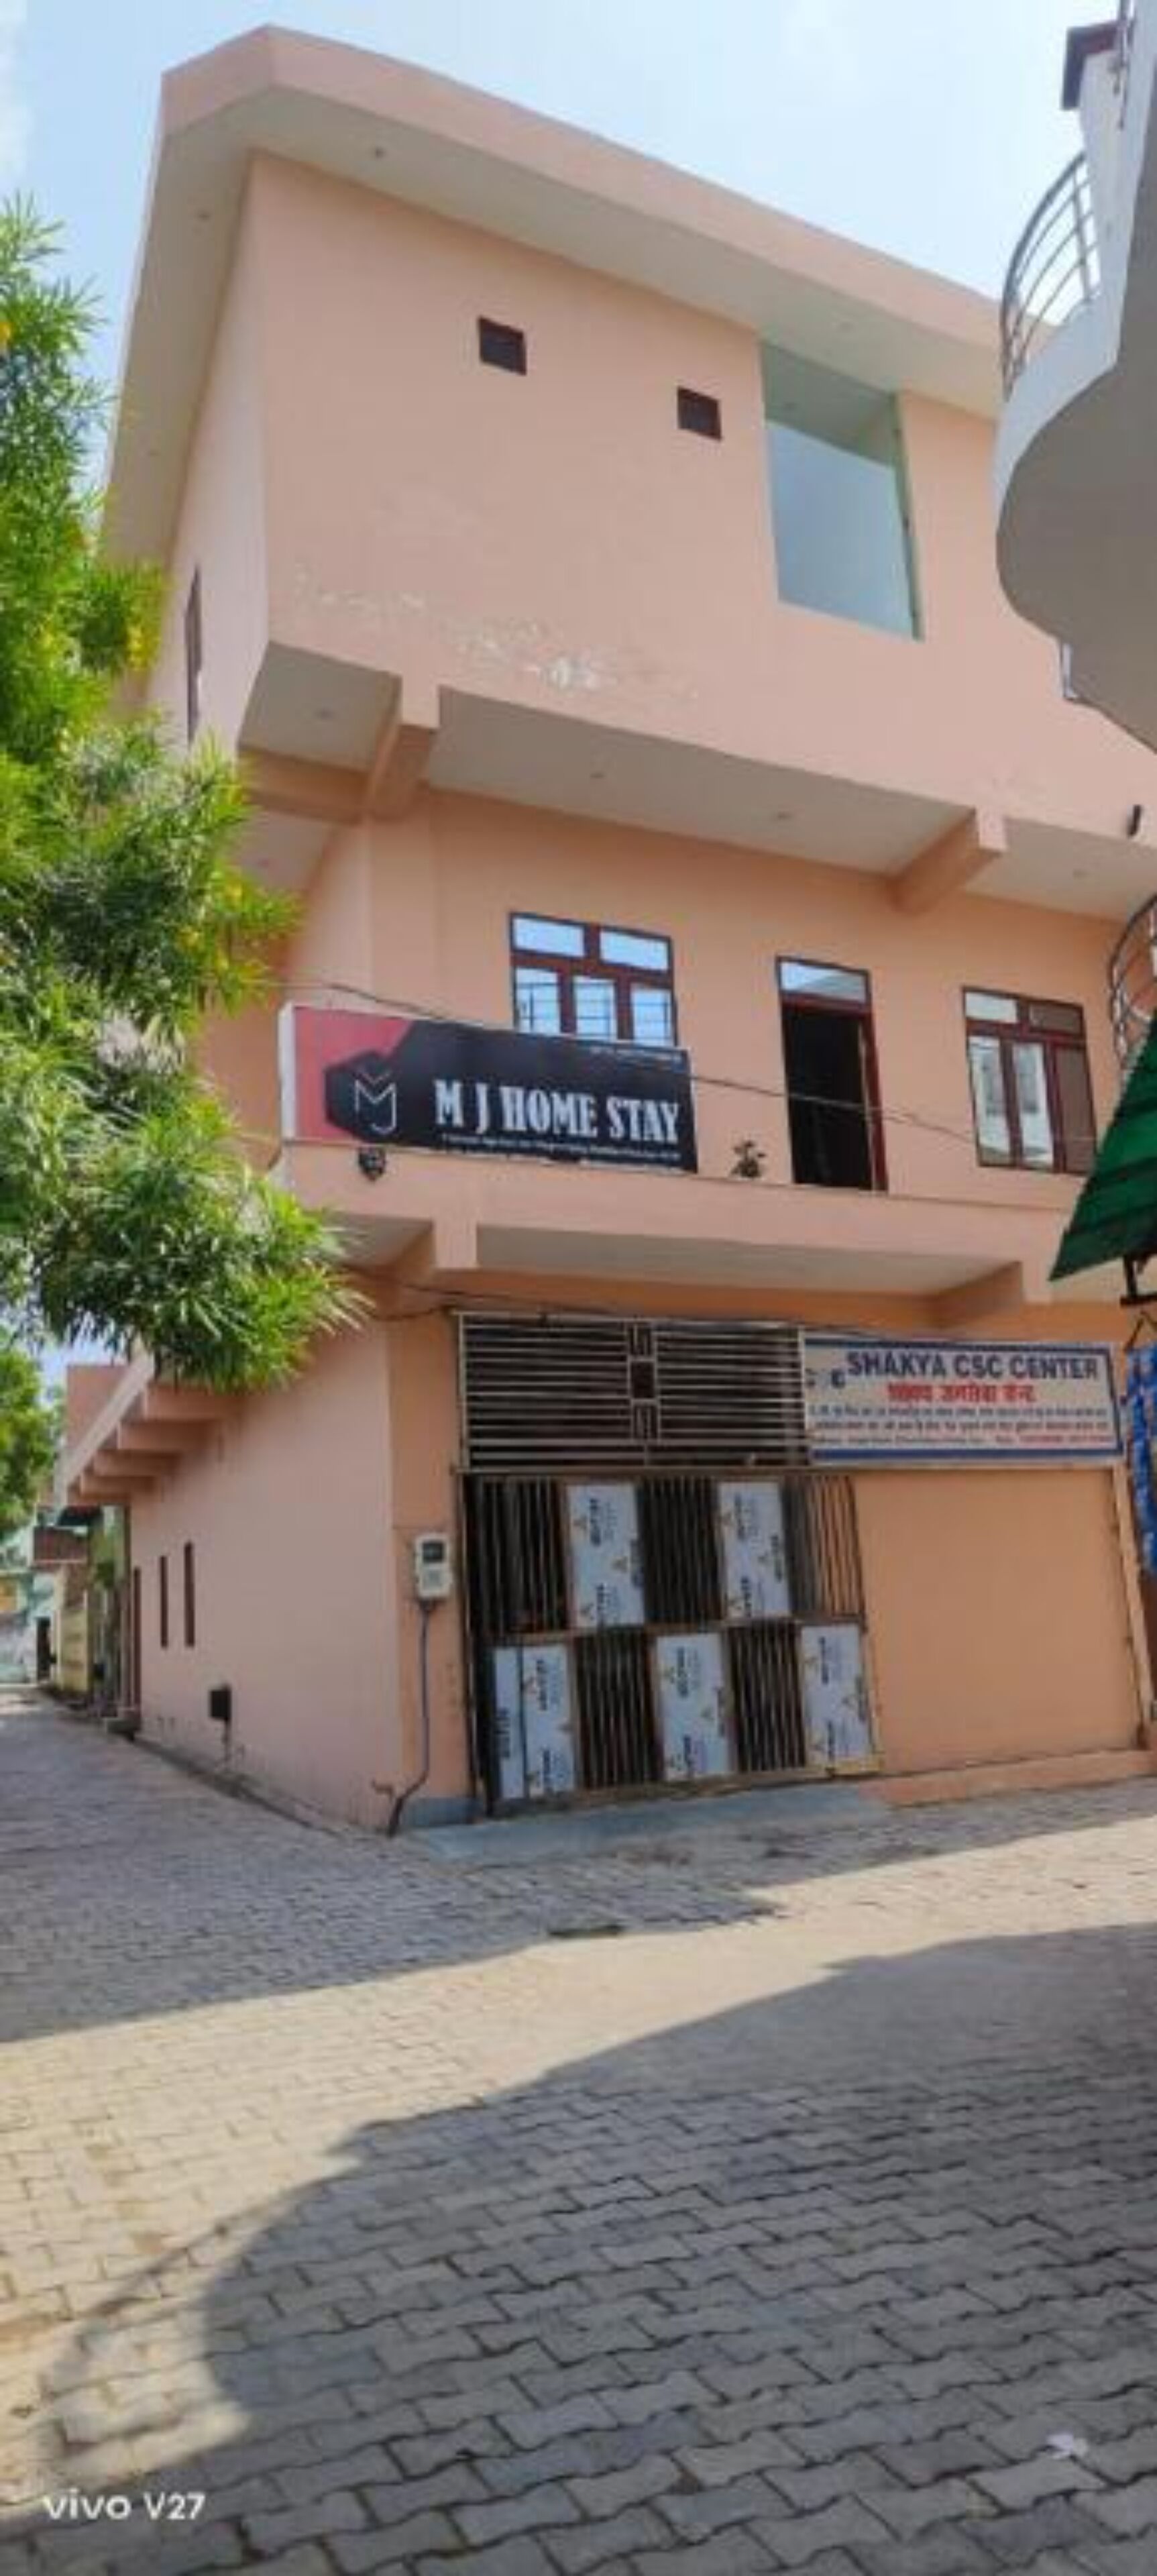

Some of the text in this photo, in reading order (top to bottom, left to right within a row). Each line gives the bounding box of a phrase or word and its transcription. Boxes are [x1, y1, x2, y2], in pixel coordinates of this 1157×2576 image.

[434, 1078, 680, 1144] M J HOME STAY
[847, 1351, 946, 1377] SHAKYA
[953, 1354, 1003, 1378] CSC
[1009, 1356, 1098, 1381] CENTER
